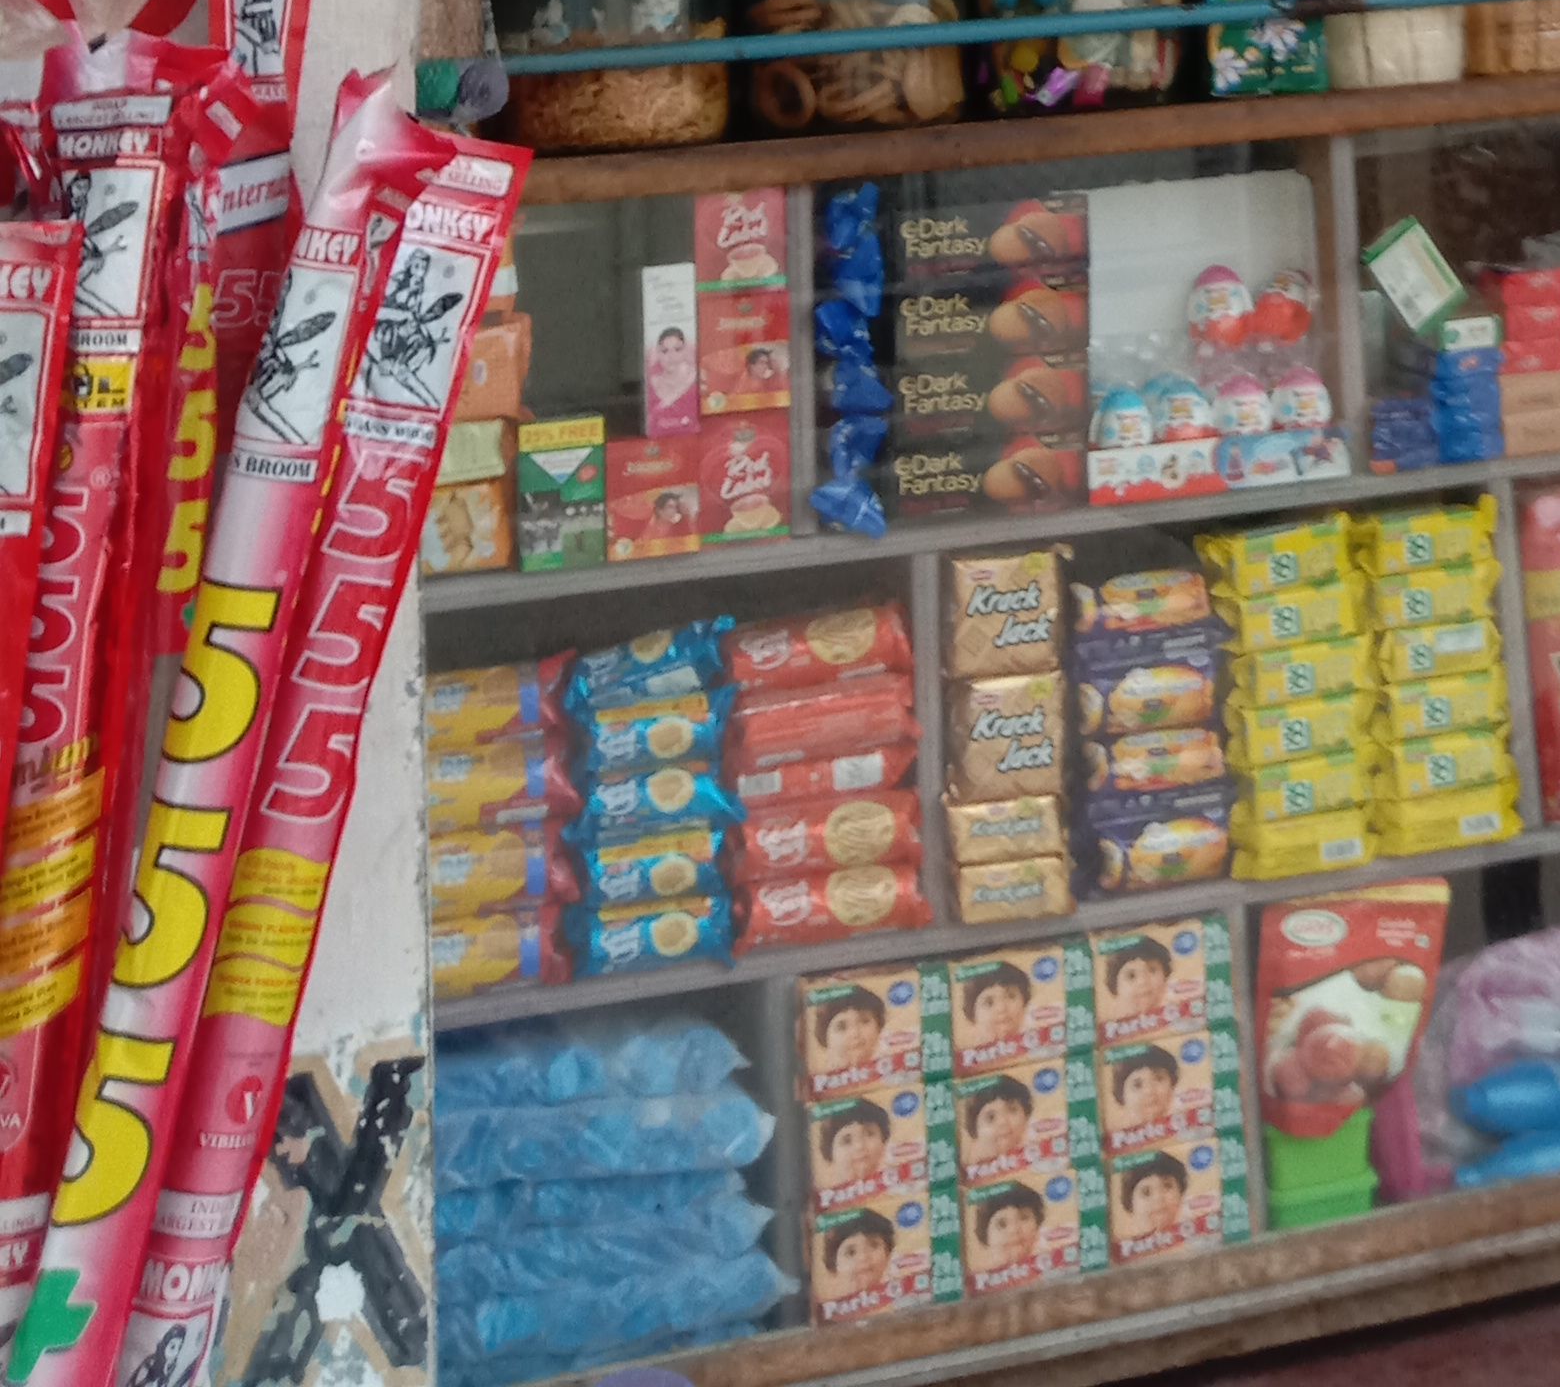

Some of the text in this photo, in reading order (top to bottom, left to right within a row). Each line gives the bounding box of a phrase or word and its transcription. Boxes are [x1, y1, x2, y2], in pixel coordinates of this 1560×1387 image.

[59, 129, 151, 161] MONKEY
[404, 199, 495, 246] ONKEY
[920, 216, 969, 240] Dark
[297, 227, 360, 266] KEY
[905, 236, 988, 259] Fantasy
[921, 293, 971, 317] Dark
[905, 313, 988, 337] Fantasy
[917, 371, 968, 395] Dark
[904, 392, 986, 415] Fantasy
[558, 424, 599, 440] FREE
[245, 454, 313, 480] BROOM
[911, 453, 963, 477] Dark
[900, 472, 983, 496] Fantasy
